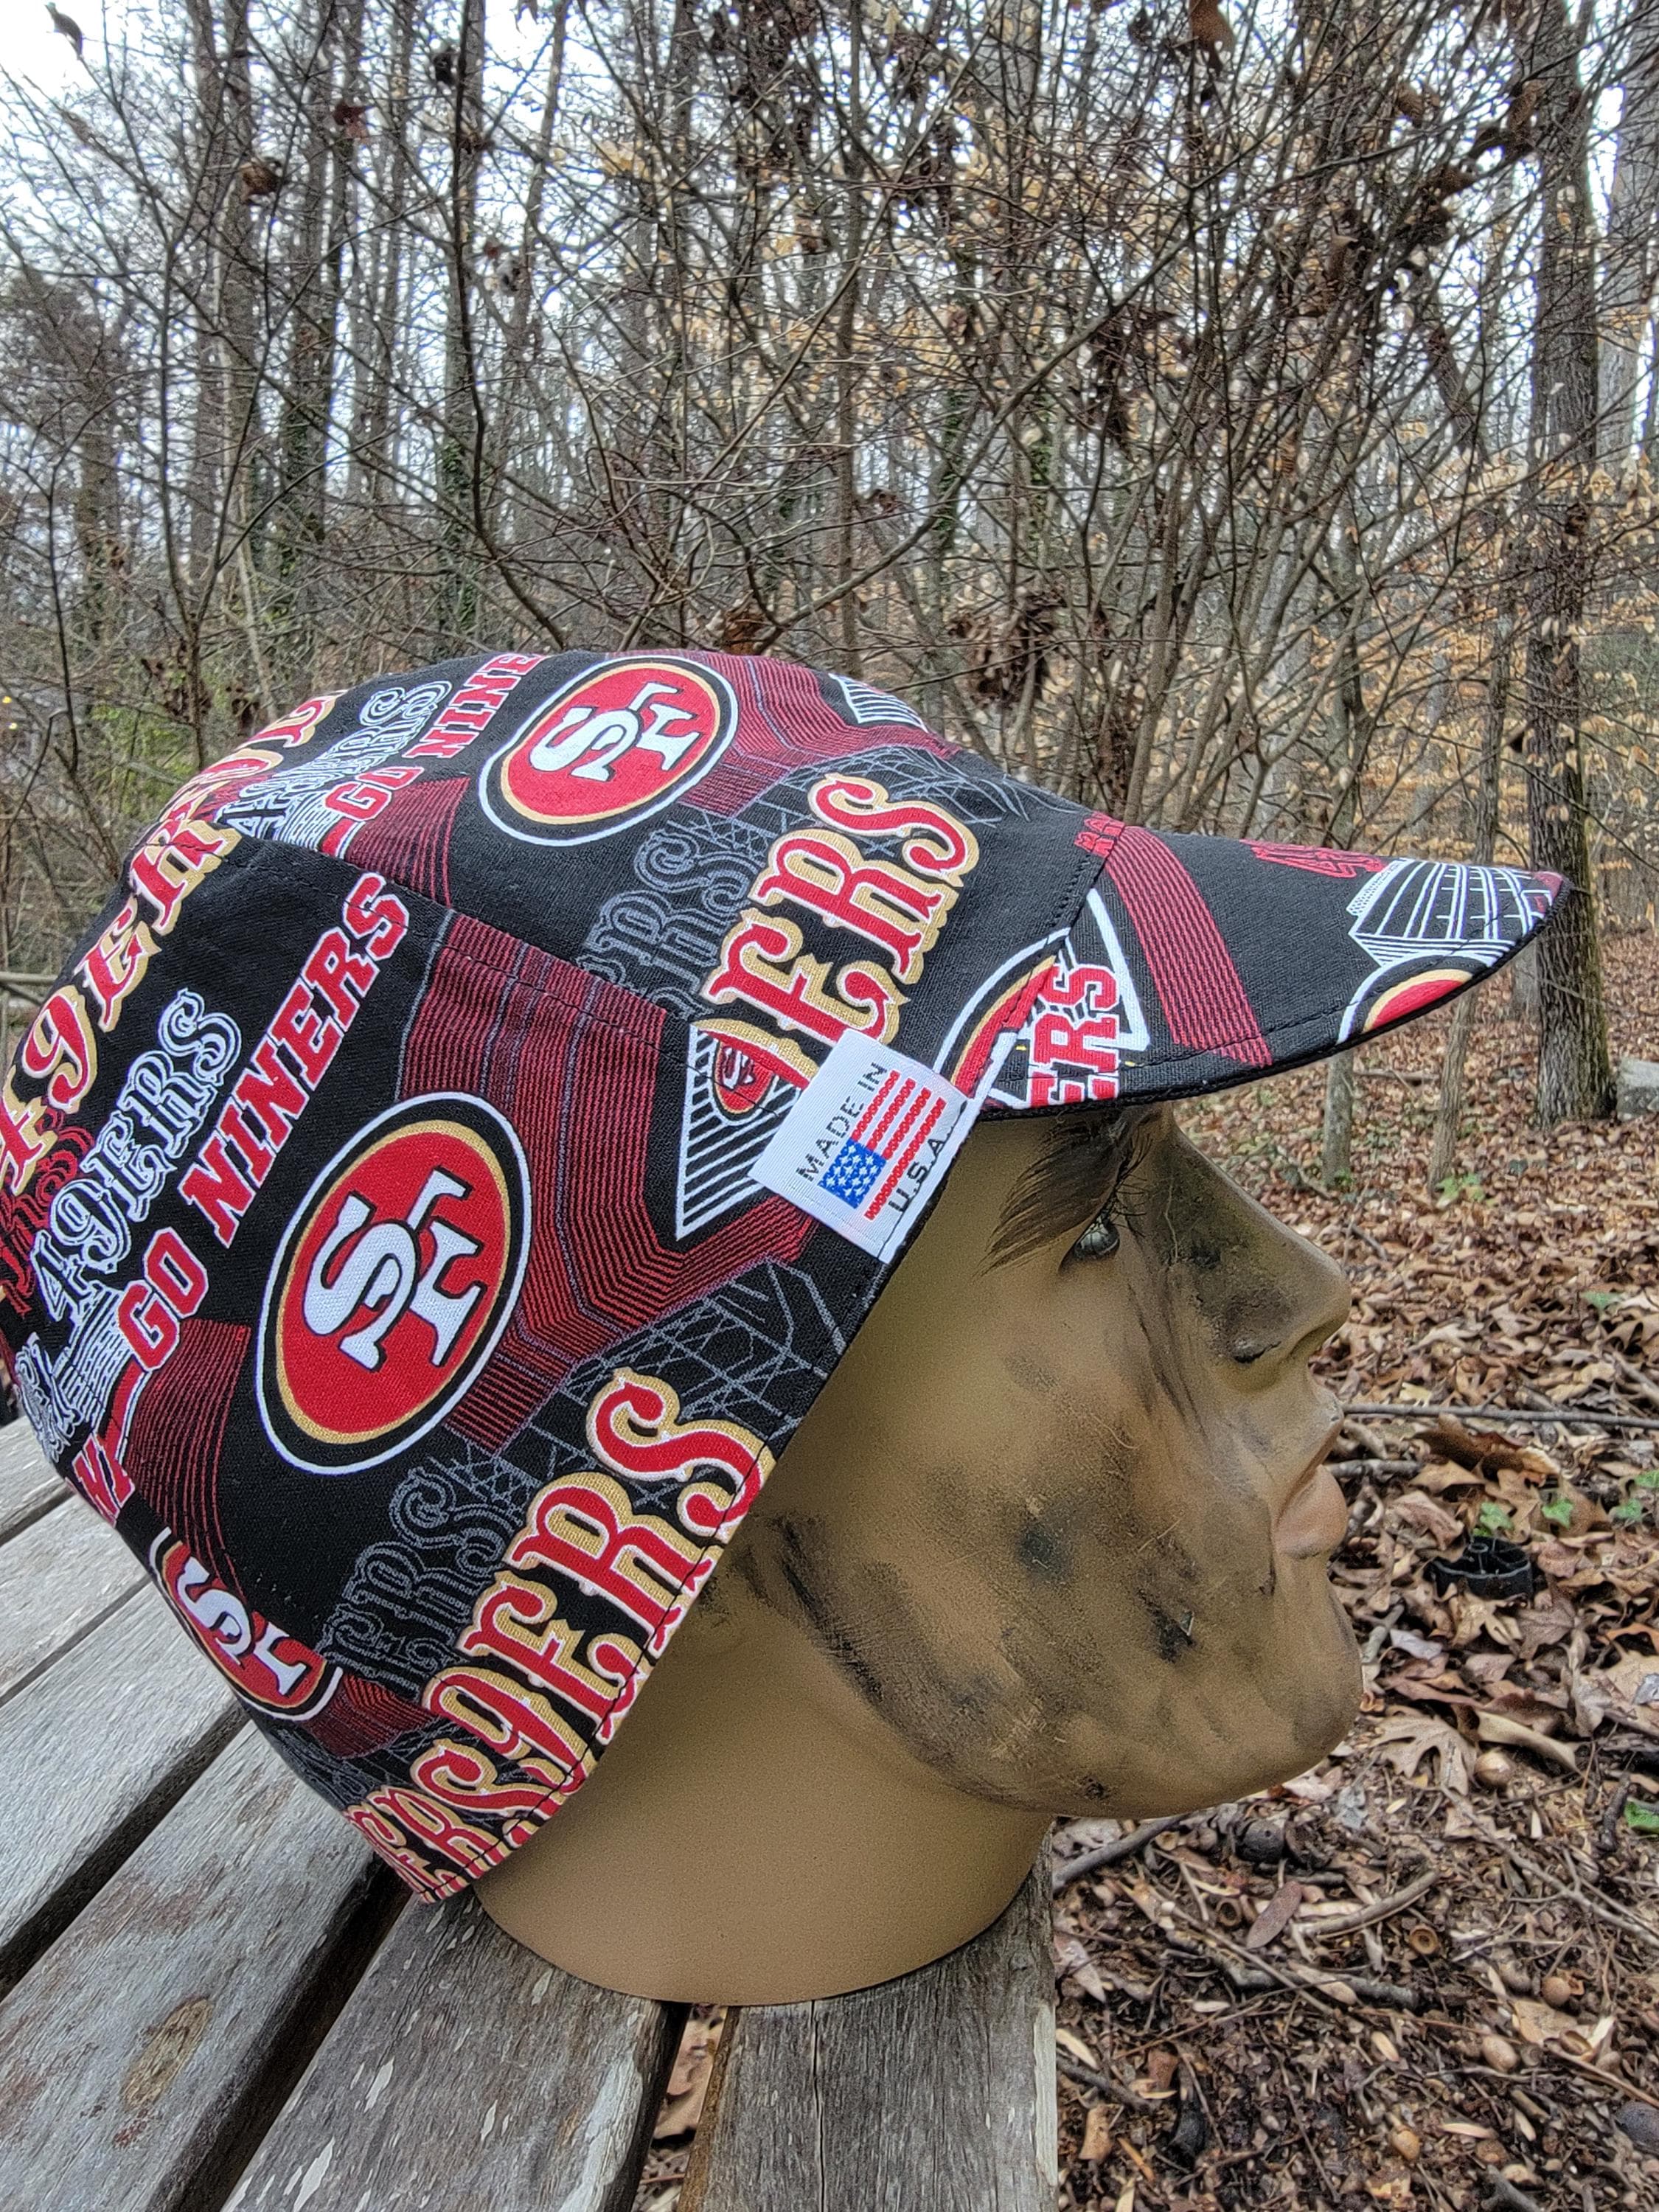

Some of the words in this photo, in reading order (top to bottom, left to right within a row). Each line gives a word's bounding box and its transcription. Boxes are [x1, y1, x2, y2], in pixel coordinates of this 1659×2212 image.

[29, 988, 242, 1323] 49ERS
[117, 1226, 210, 1371] GO
[177, 872, 410, 1249] NINERS
[796, 1095, 864, 1183] MADE
[858, 1060, 888, 1093] IN
